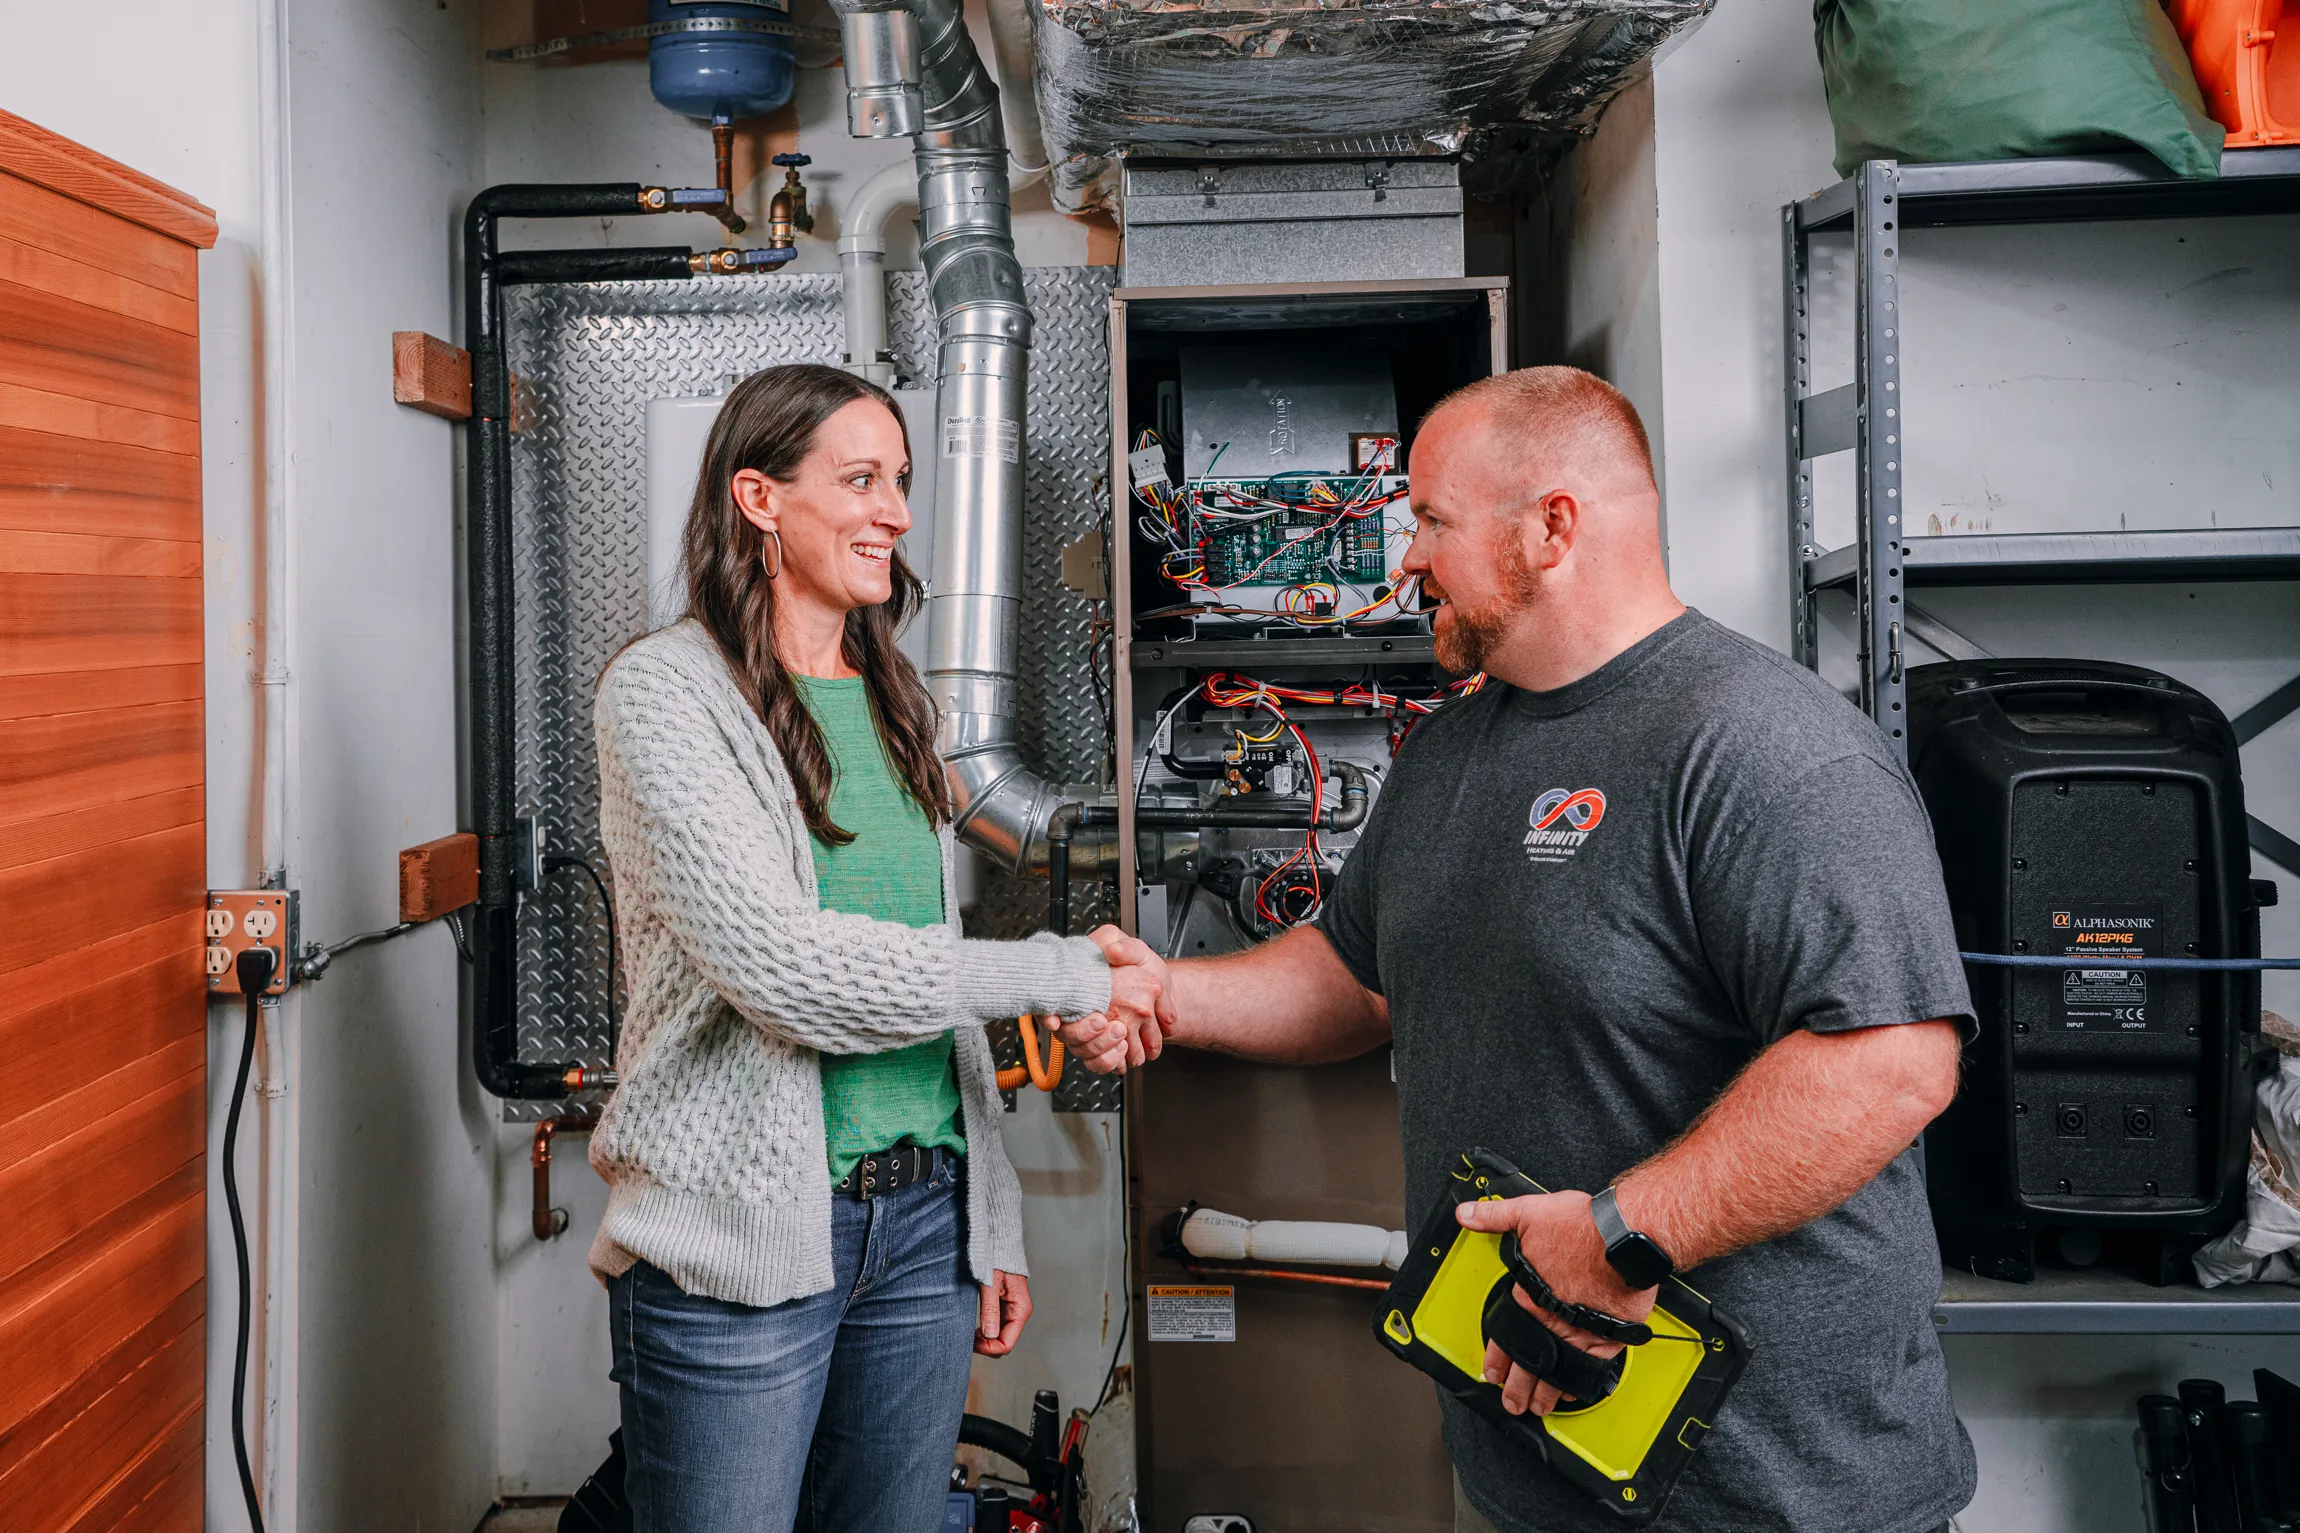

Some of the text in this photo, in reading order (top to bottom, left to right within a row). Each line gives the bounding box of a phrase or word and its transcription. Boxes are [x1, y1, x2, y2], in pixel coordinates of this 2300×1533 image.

[1276, 398, 1287, 445] ROTATION
[1268, 752, 1274, 762] ON
[1523, 830, 1589, 846] INFINITY
[2076, 933, 2134, 943] AK12PKG
[2098, 946, 2121, 954] Speaker
[2121, 946, 2144, 954] System
